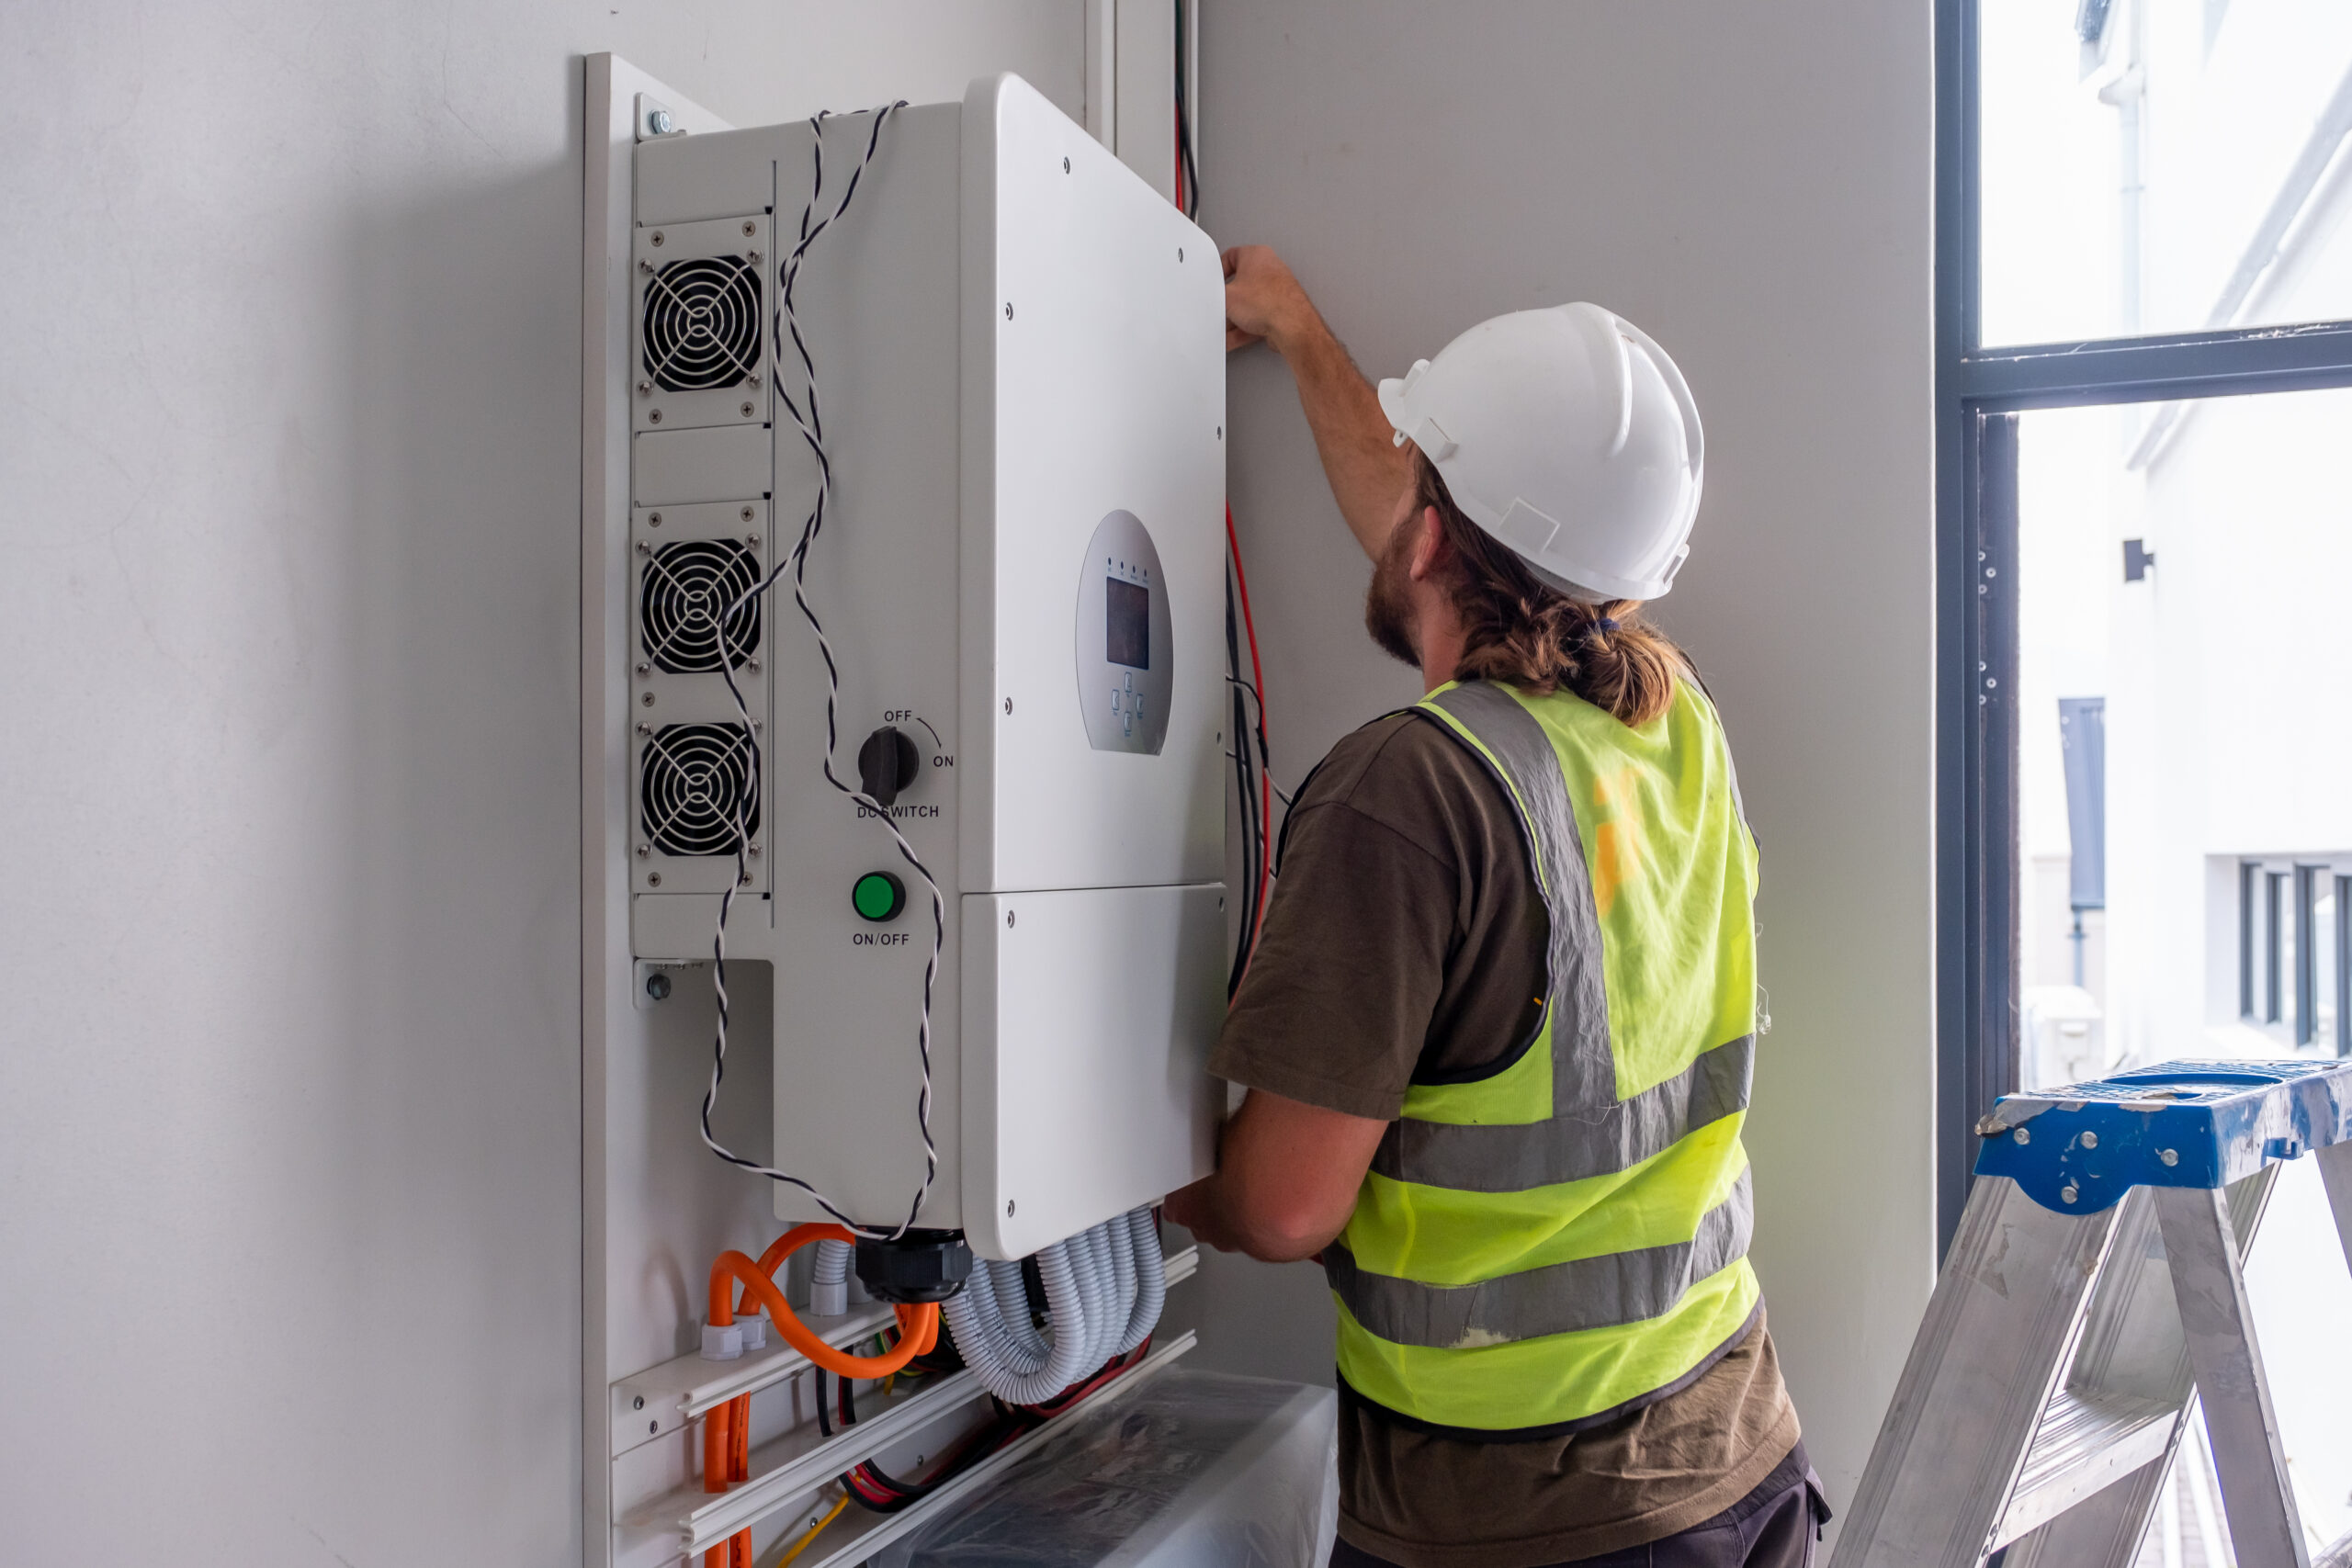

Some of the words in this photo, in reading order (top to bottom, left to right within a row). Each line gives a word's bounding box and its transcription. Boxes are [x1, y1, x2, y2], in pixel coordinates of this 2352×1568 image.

[884, 710, 912, 722] OFF
[933, 755, 954, 768] ON
[857, 807, 877, 818] DC
[881, 806, 939, 818] SWITCH
[853, 932, 910, 946] ON/OFF
